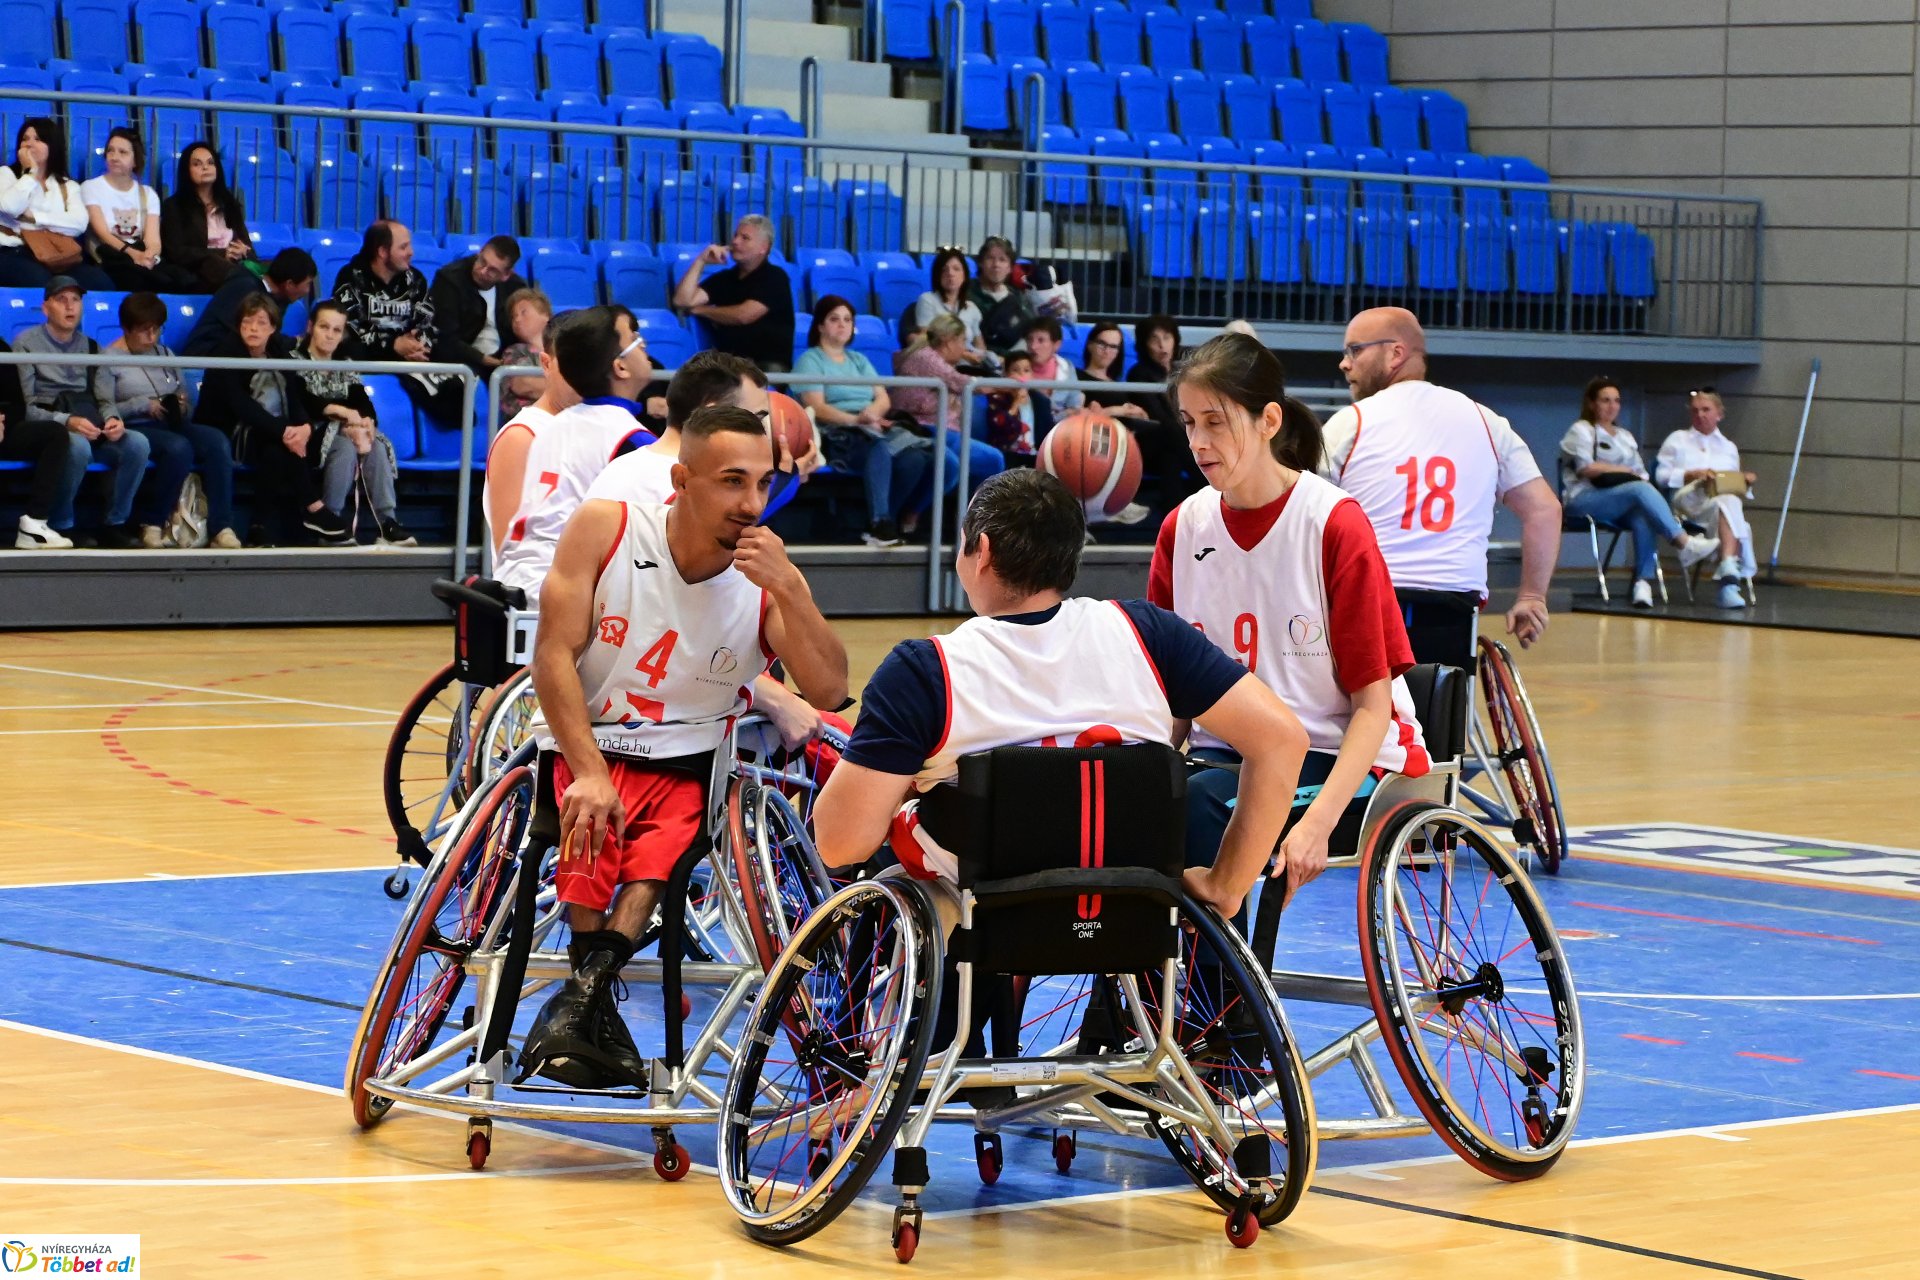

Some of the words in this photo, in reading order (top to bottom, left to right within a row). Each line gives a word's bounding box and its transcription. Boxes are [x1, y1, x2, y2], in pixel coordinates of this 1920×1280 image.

[1395, 455, 1457, 533] 18
[635, 628, 679, 689] 4
[1233, 612, 1258, 674] 9
[594, 736, 652, 754] mda.hu
[1072, 921, 1102, 931] SPORTA
[1078, 930, 1095, 939] ONE
